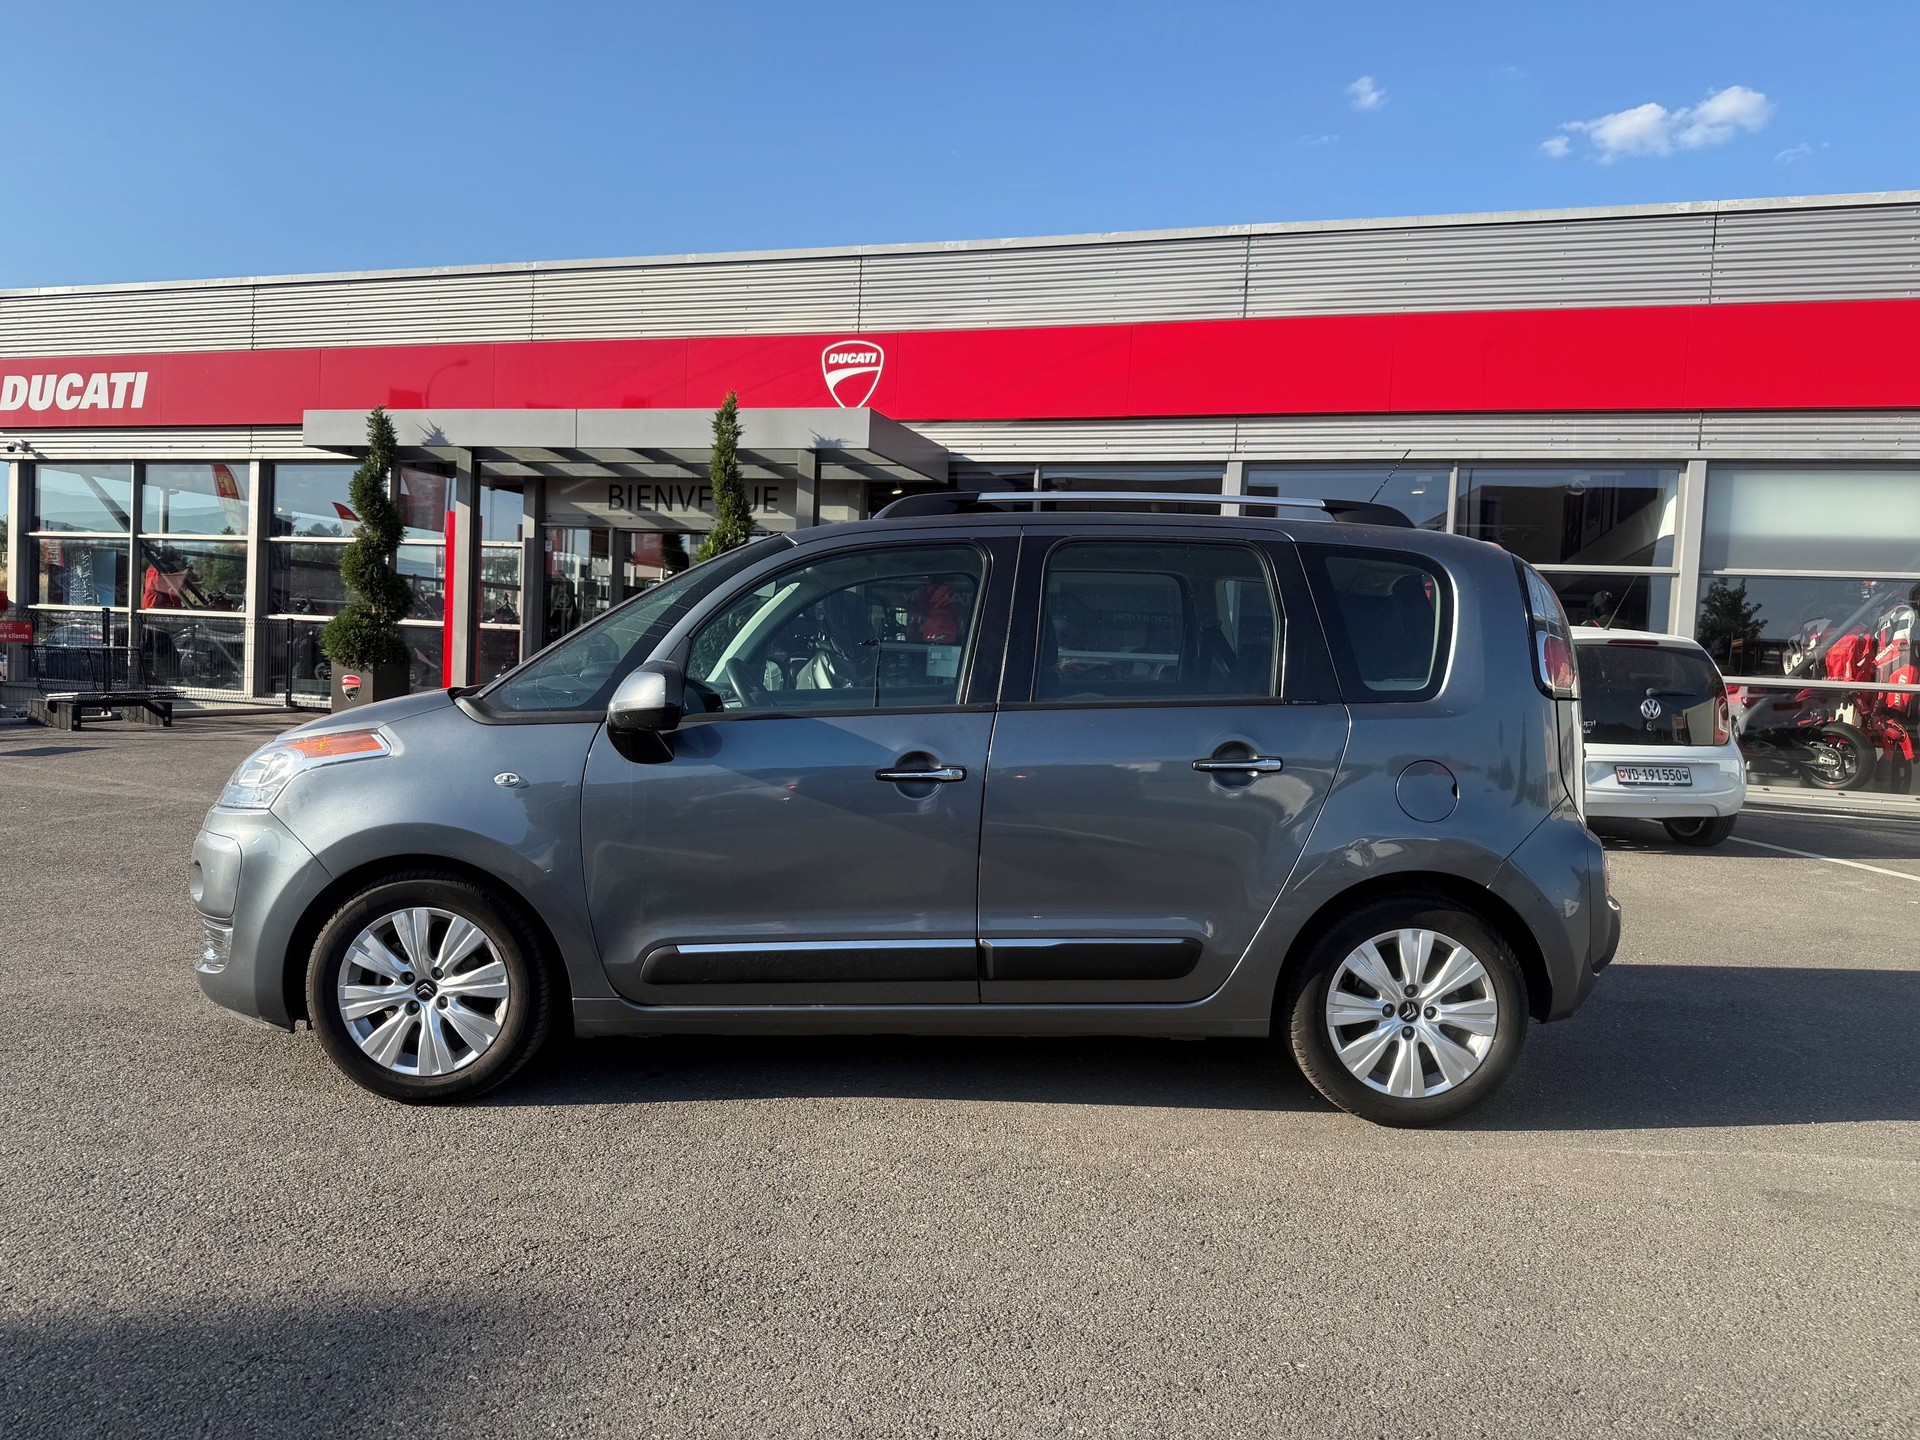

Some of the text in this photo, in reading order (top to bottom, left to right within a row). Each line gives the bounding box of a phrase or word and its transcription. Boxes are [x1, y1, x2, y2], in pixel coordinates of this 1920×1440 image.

[829, 352, 877, 364] DUCATI
[0, 371, 149, 411] DUCATI
[608, 484, 779, 514] BIENVEUE
